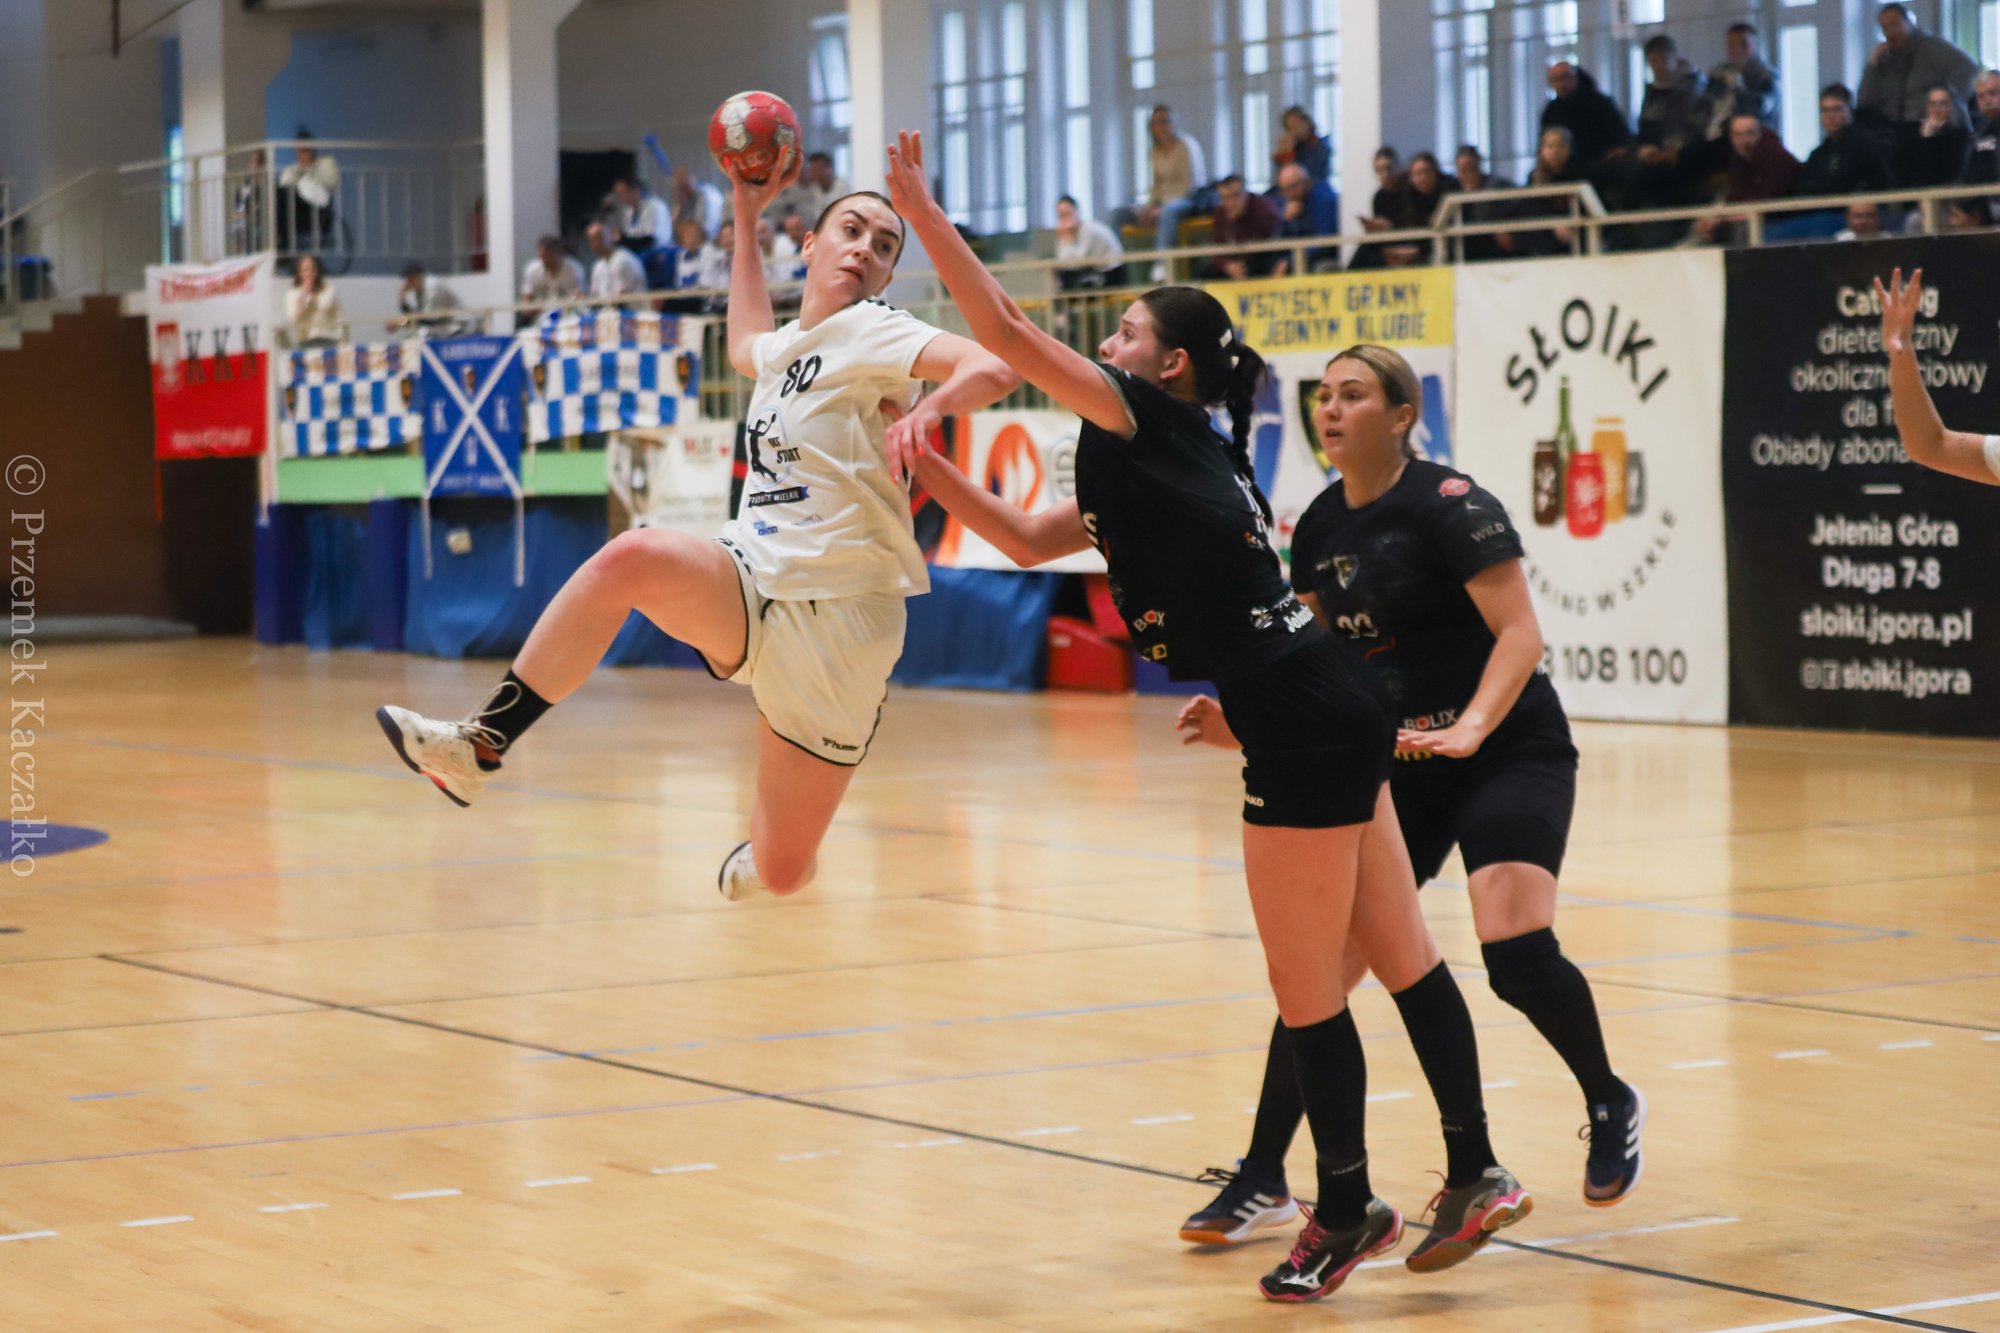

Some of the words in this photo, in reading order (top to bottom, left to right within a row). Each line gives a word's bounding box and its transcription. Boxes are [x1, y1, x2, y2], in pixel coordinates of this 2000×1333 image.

[1237, 288, 1331, 319] WSZYSCY
[1345, 283, 1421, 312] GRAMY
[1837, 285, 1939, 318] Catg
[1262, 317, 1340, 346] JEDNYM
[1356, 311, 1426, 341] KLUBIE
[1817, 323, 1959, 356] dietezny
[1506, 298, 1671, 405] SŁOIKI
[1841, 395, 1878, 428] dla
[777, 447, 801, 464] START
[1751, 432, 1836, 471] Obiady
[1470, 522, 1505, 542] WILD
[1808, 512, 1894, 546] Jelenia
[1896, 512, 1960, 547] Góra
[1620, 507, 1678, 601] SZKLE
[1821, 555, 1897, 595] Długa
[1900, 556, 1942, 590] 7-8
[1564, 646, 1619, 683] 108
[1629, 646, 1689, 686] 100
[1403, 709, 1458, 730] BOLIX
